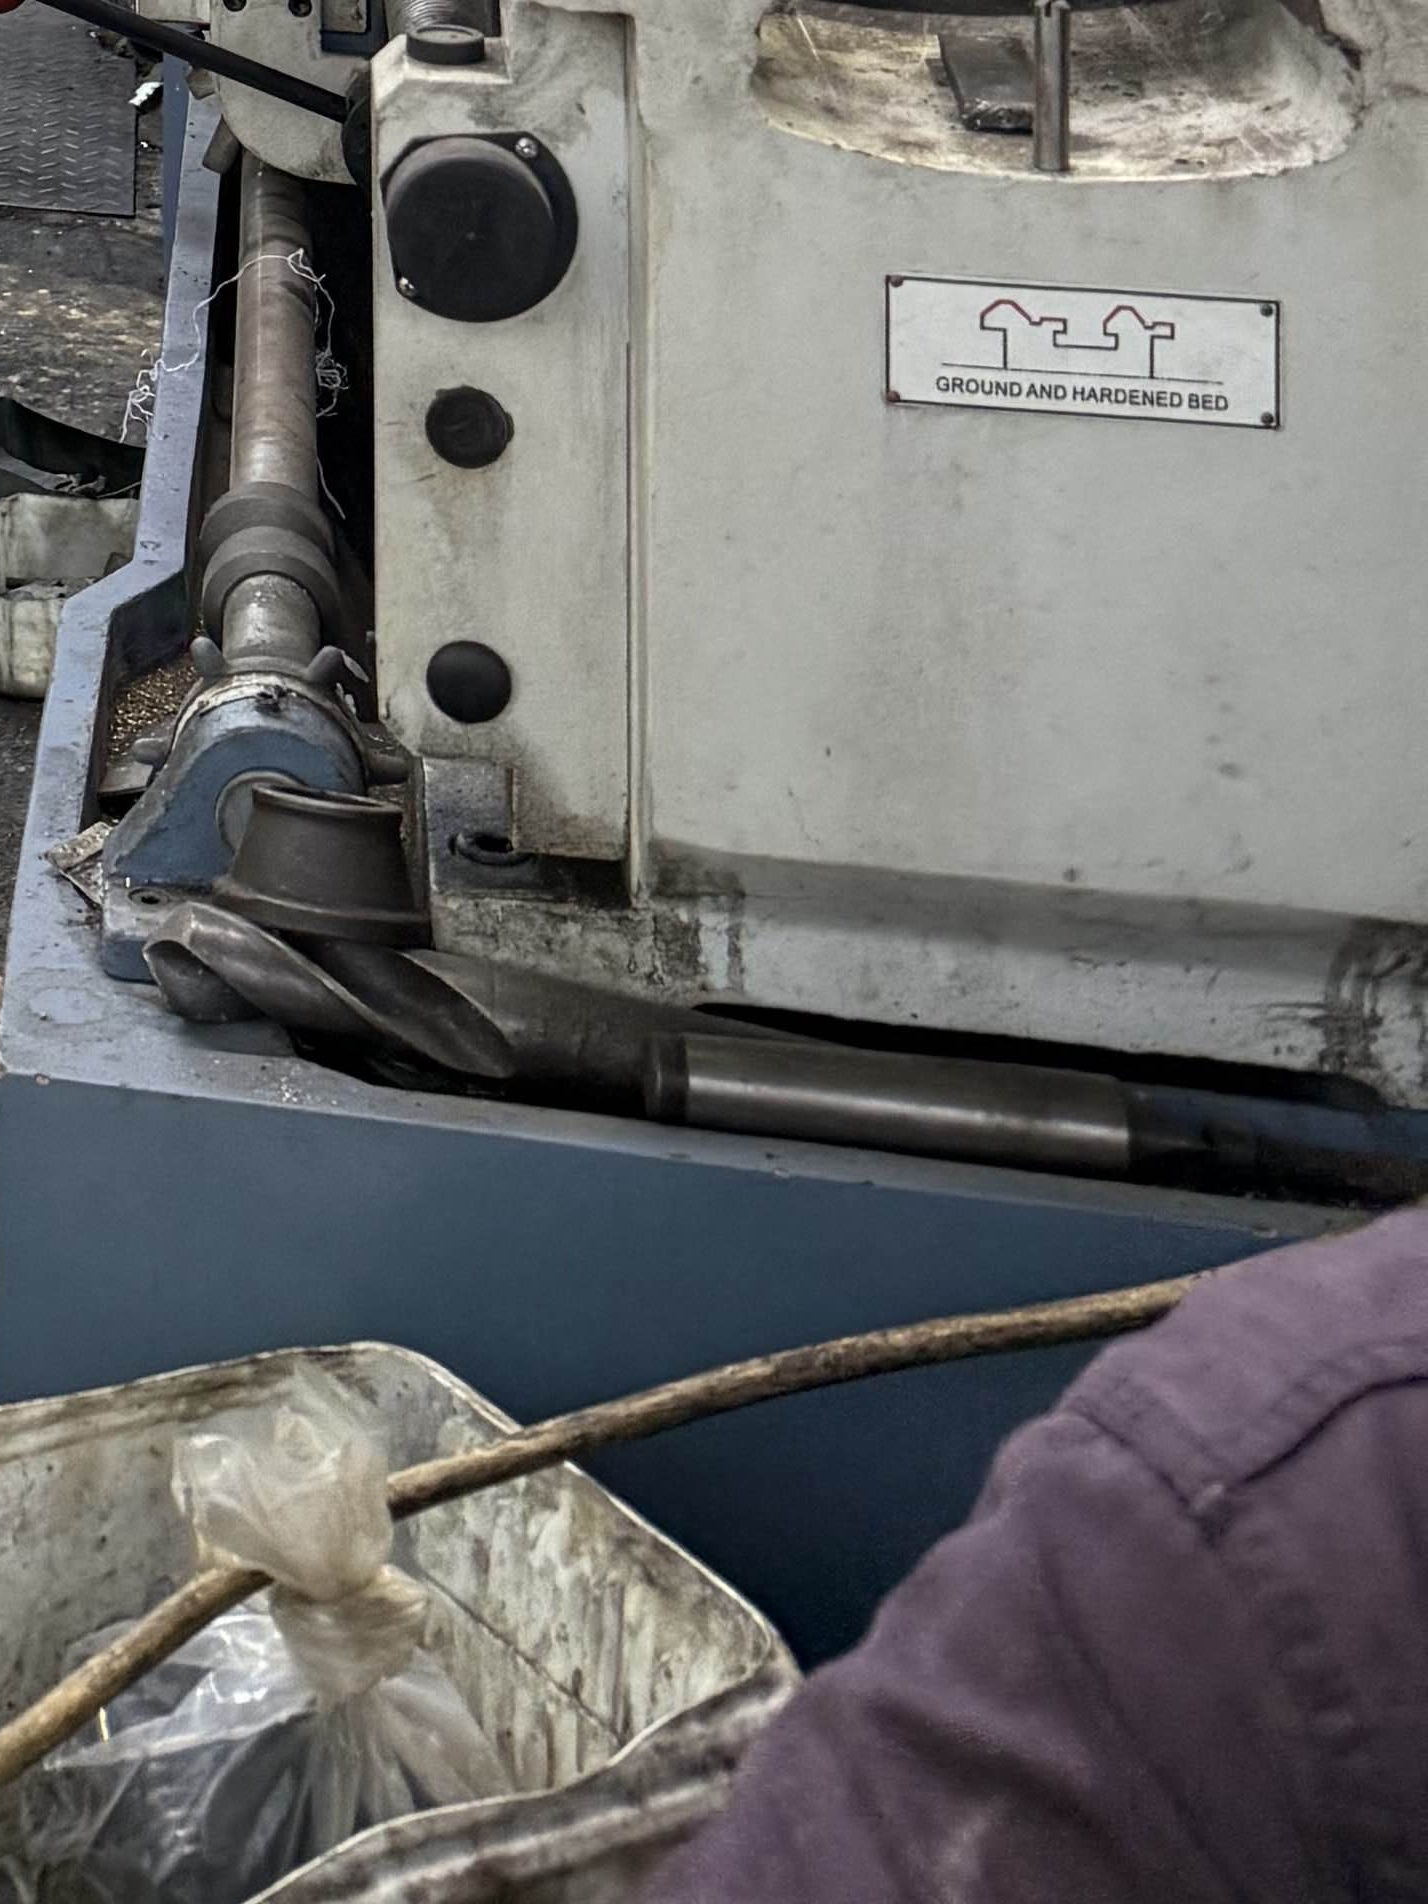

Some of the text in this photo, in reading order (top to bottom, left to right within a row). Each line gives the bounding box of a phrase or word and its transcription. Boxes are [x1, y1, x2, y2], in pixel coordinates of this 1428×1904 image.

[935, 375, 1230, 413] GROUND AND HARDENED BED
